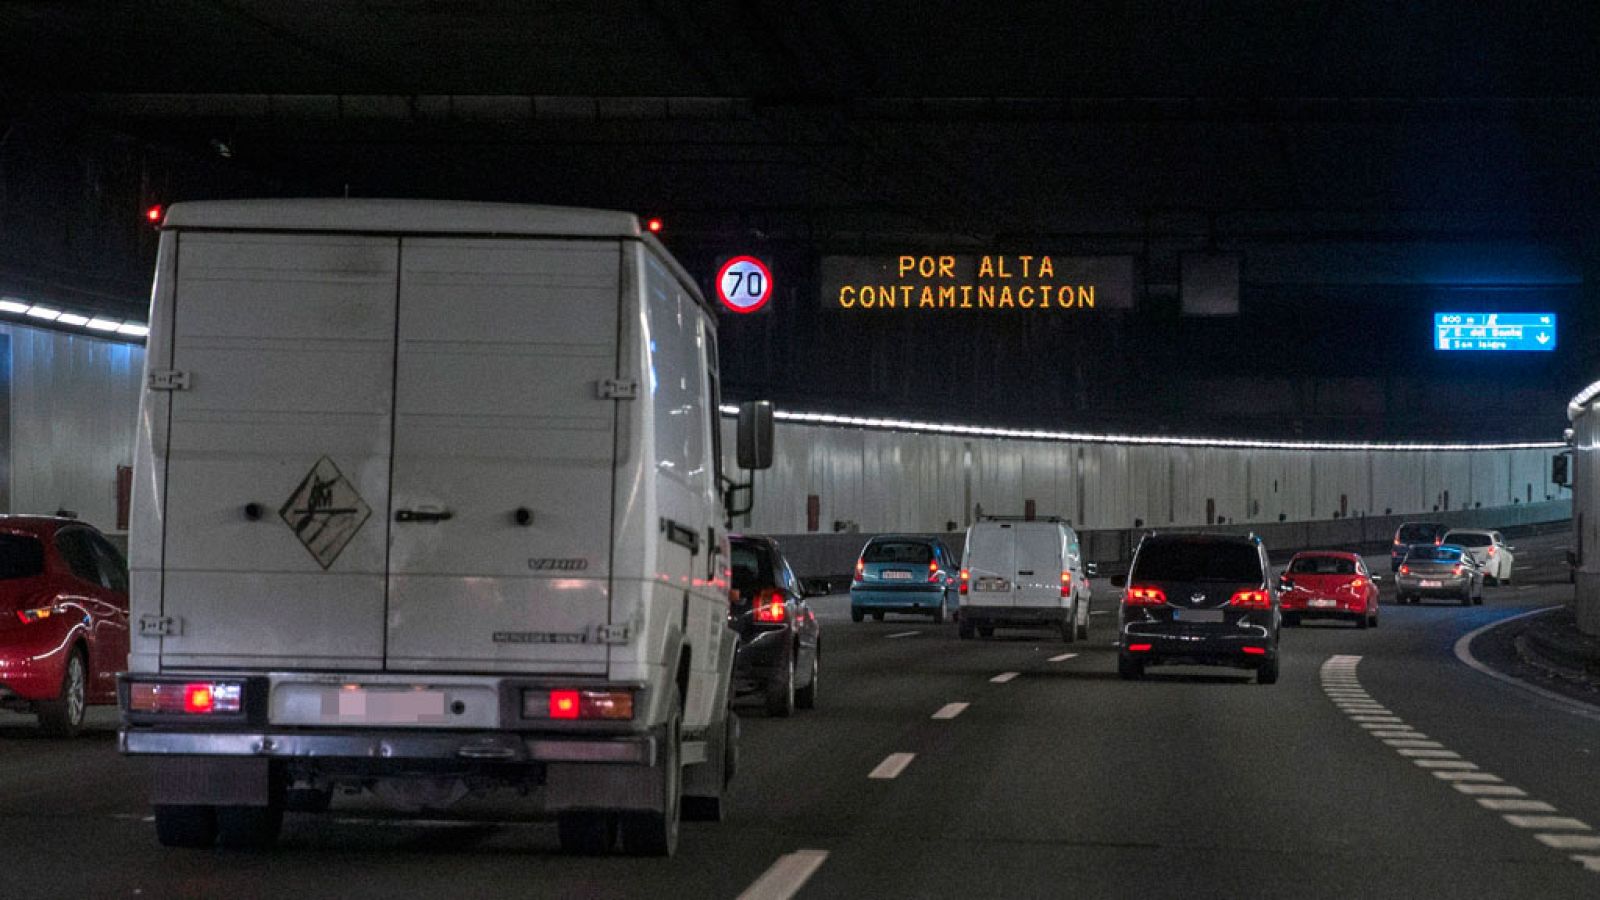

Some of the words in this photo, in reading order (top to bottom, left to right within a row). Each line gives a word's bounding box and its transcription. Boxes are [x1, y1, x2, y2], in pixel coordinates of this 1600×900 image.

[899, 255, 956, 278] POR
[978, 255, 1054, 278] ALTA
[727, 271, 762, 297] 70
[839, 285, 1096, 308] CONTAMINACION
